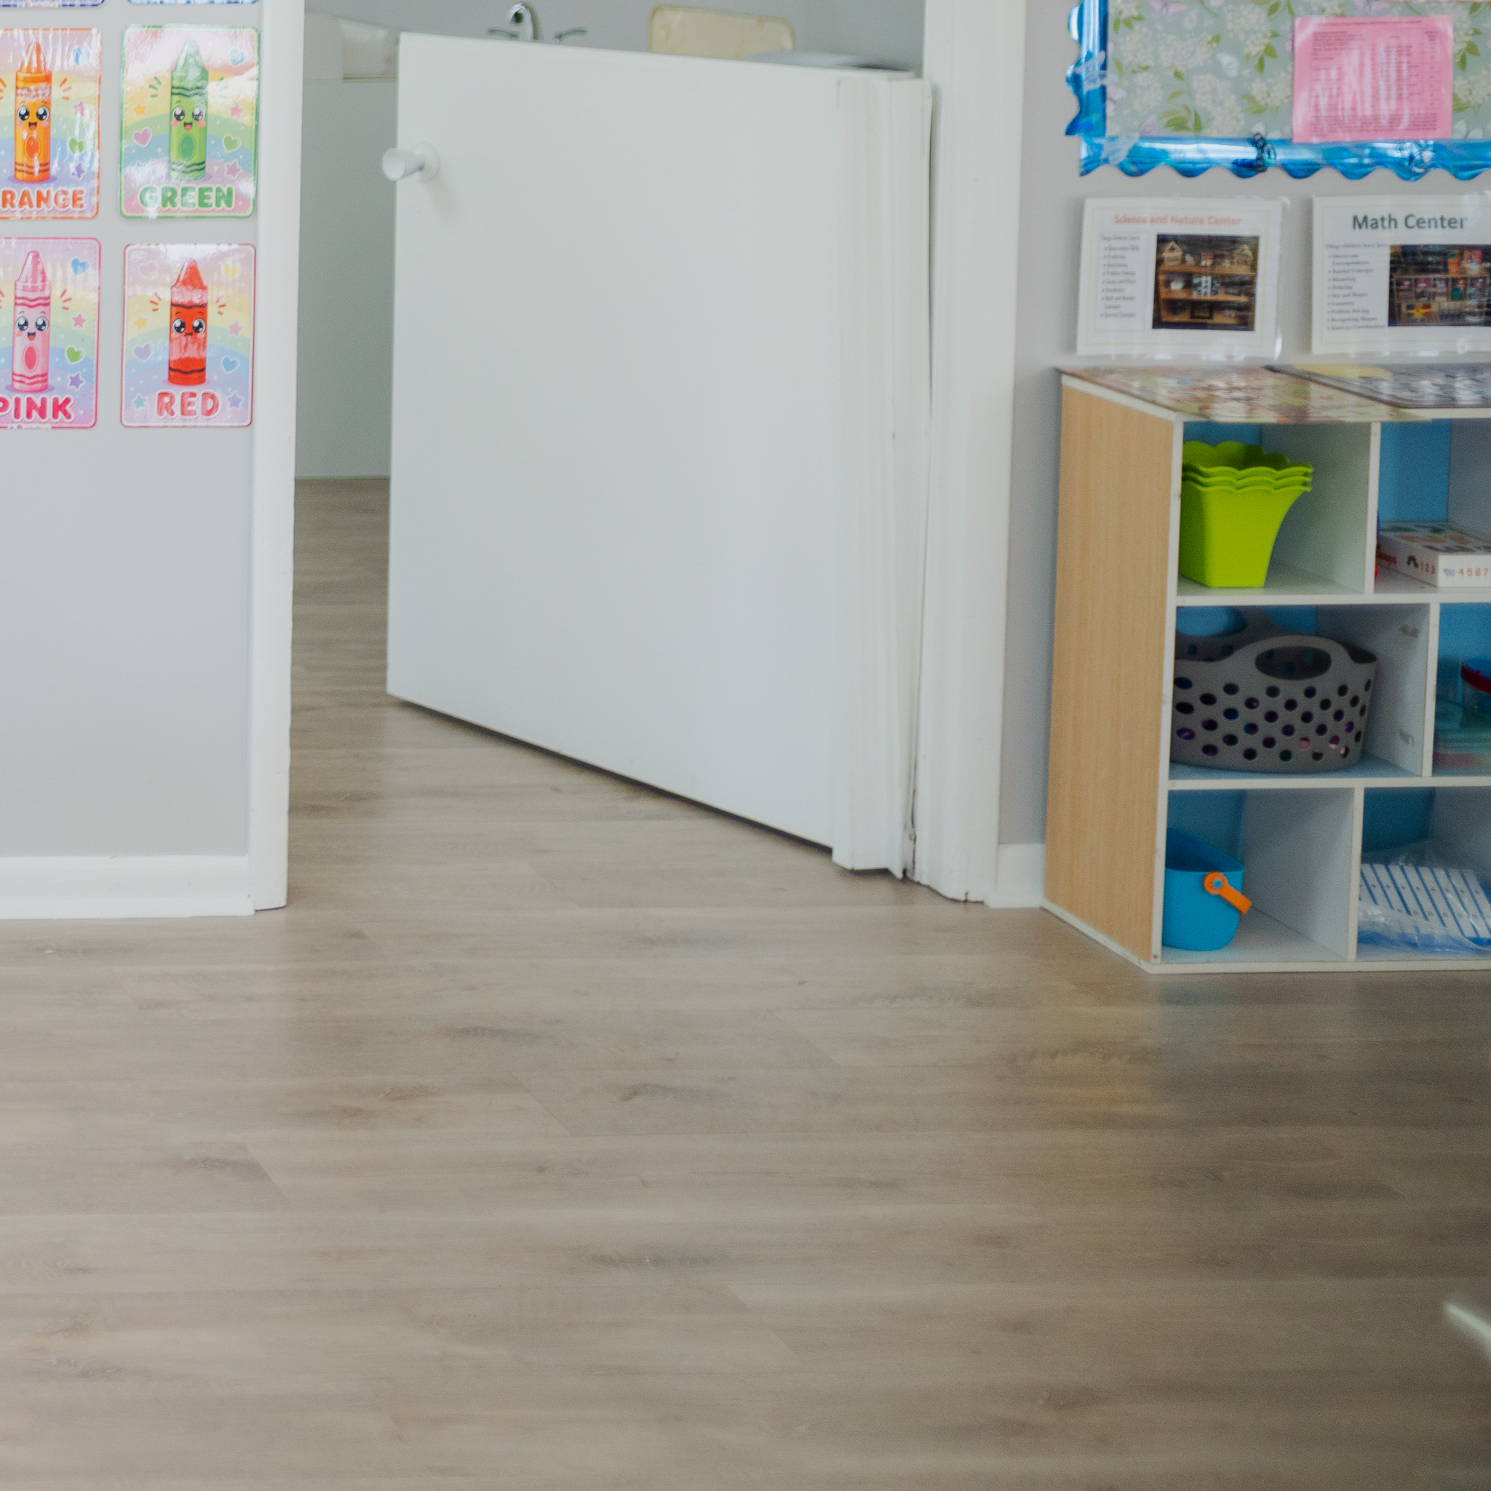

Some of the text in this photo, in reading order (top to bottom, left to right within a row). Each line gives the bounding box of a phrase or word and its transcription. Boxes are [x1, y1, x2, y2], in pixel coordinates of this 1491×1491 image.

[140, 187, 233, 208] GREEN
[1352, 214, 1468, 231] Math Center
[157, 392, 220, 416] RED
